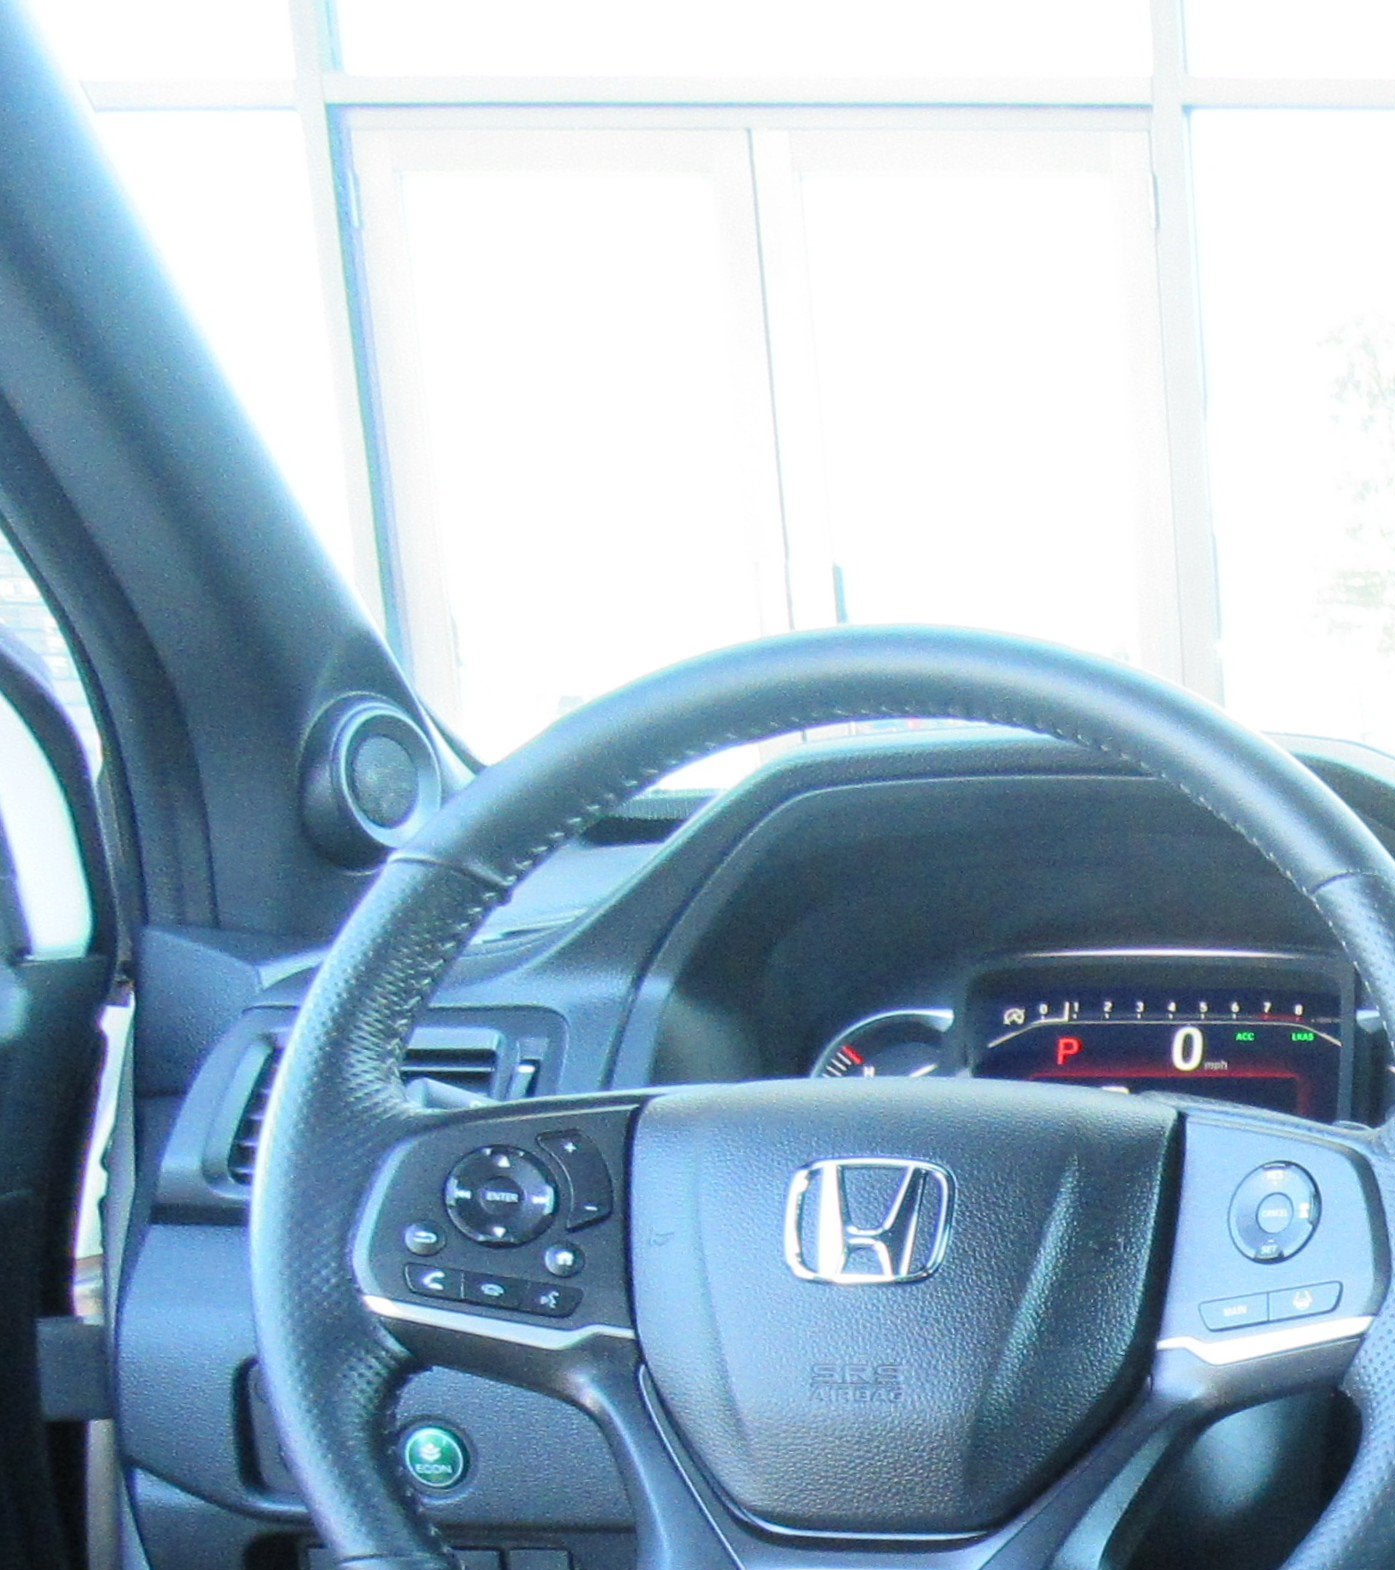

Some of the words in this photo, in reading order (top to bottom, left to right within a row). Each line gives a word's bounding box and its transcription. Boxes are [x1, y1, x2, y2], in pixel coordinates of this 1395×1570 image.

[1039, 1004, 1048, 1014] 0
[1104, 1001, 1113, 1012] 2
[1136, 1001, 1144, 1012] 3
[1167, 1001, 1176, 1012] 4
[1200, 1001, 1208, 1012] 5
[1231, 1001, 1240, 1013] 6
[1263, 1001, 1272, 1013] 7
[1295, 1004, 1303, 1015] 8
[1235, 1032, 1255, 1041] ACC
[1291, 1032, 1315, 1042] LKAS
[1057, 1037, 1082, 1065] P
[1171, 1026, 1204, 1072] 0
[486, 1191, 519, 1203] ENTER
[810, 1363, 902, 1384] SRS
[415, 1463, 453, 1474] ECON
